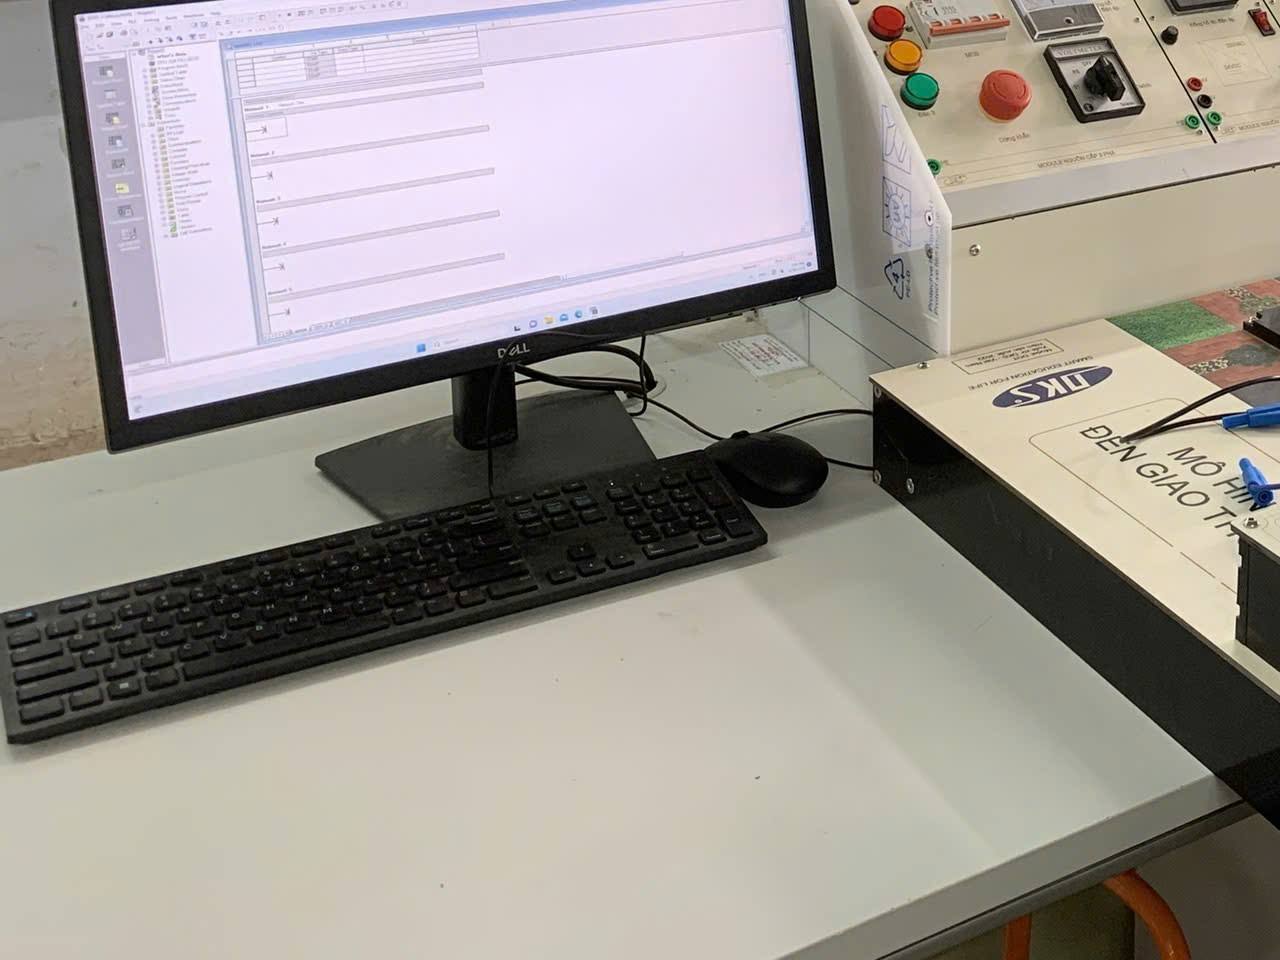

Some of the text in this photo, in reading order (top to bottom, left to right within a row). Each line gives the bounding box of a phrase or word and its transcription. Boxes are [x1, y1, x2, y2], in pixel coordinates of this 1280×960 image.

[497, 342, 530, 359] DELL
[1167, 447, 1226, 477] MÔ
[1136, 462, 1210, 507] GIAO
